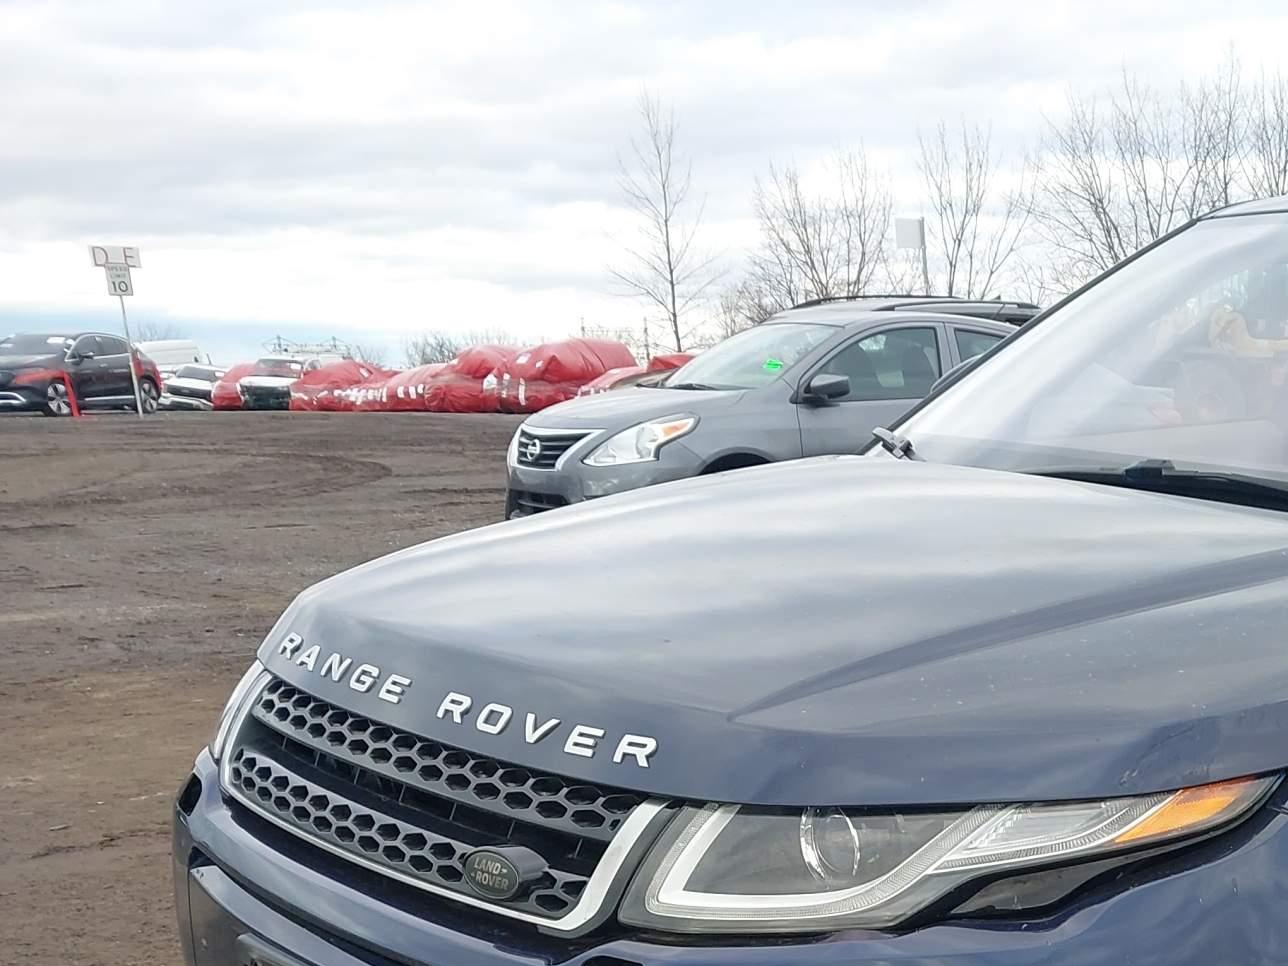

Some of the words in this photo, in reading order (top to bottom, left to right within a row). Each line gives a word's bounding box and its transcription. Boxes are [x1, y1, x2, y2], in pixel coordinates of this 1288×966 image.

[112, 280, 128, 293] 10
[277, 631, 413, 704] RANGE
[435, 691, 658, 768] ROVER
